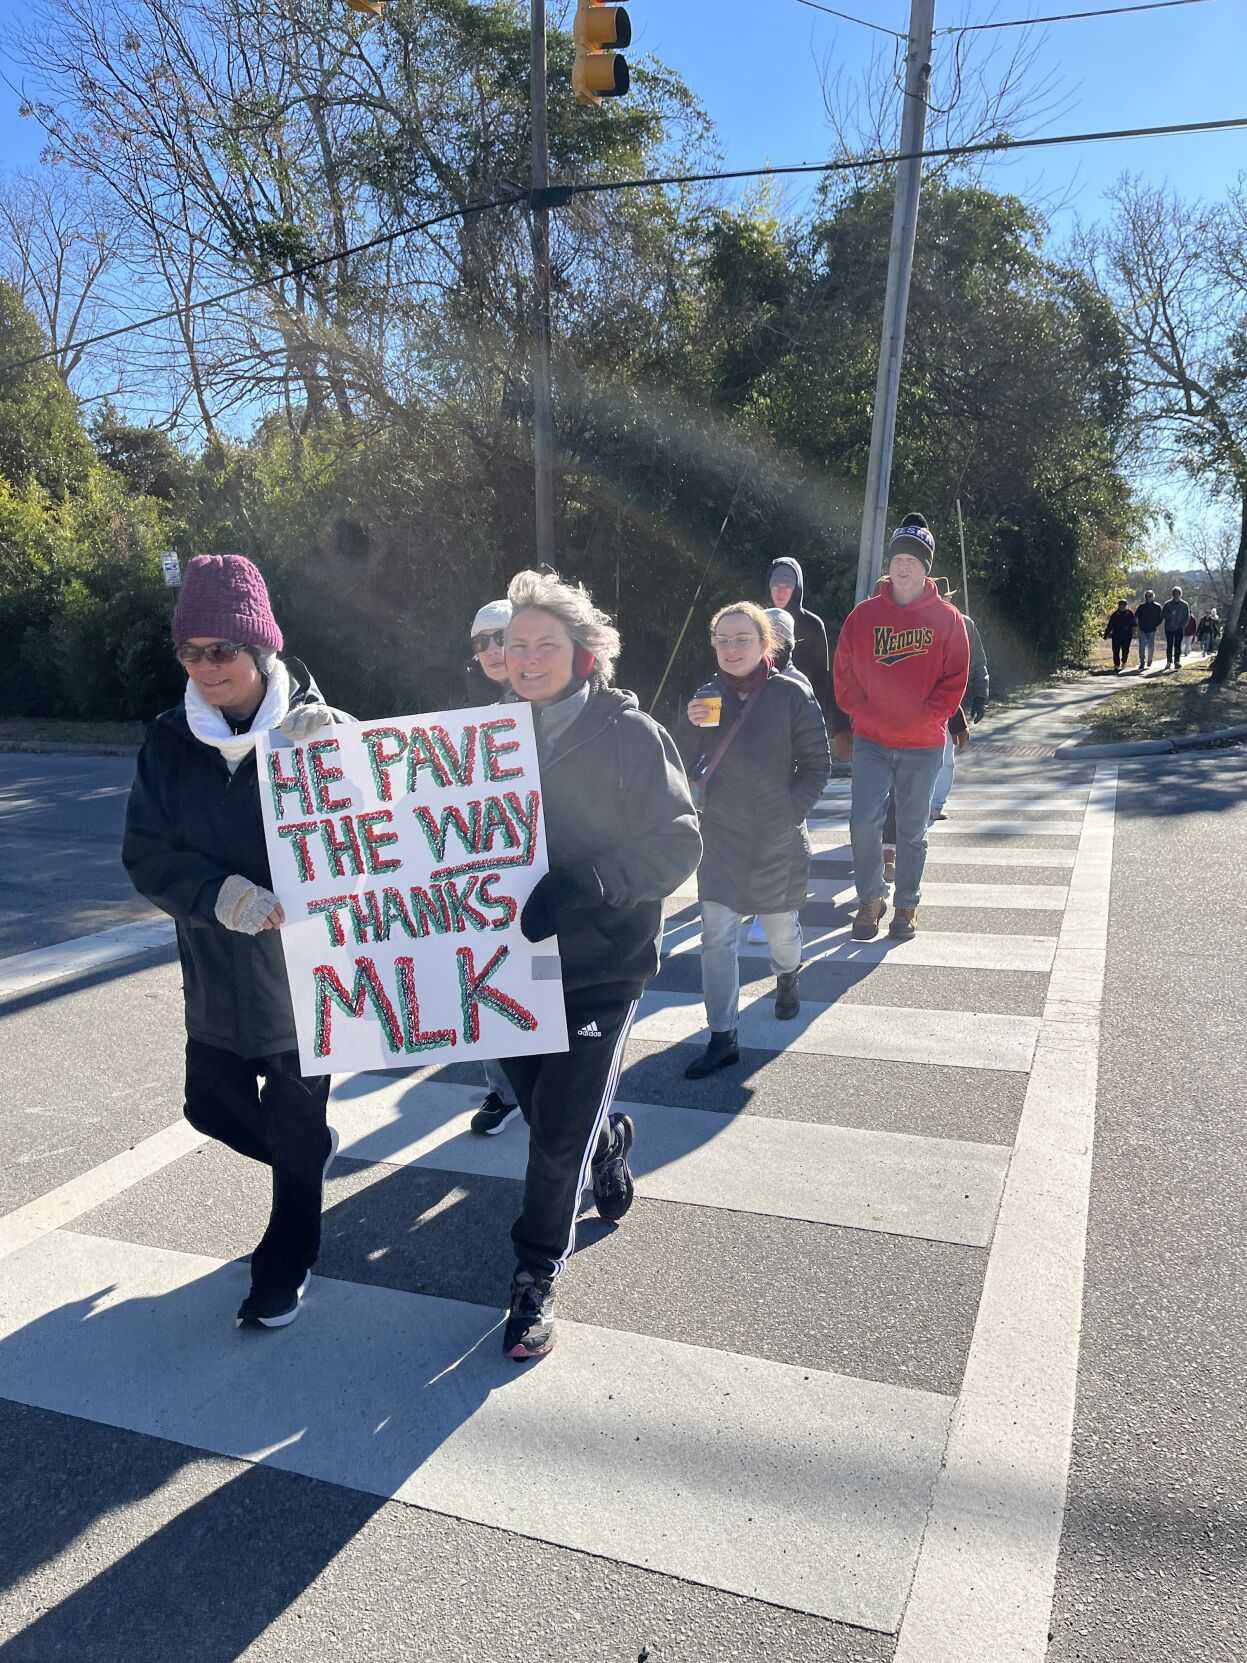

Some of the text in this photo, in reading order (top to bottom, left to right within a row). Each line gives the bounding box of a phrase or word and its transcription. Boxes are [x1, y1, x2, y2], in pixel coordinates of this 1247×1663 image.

[265, 718, 525, 820] HE PAVE
[278, 790, 540, 883] THE WAY
[307, 873, 518, 947] THANKS
[312, 944, 538, 1058] MLK
[577, 1029, 602, 1038] adidas
